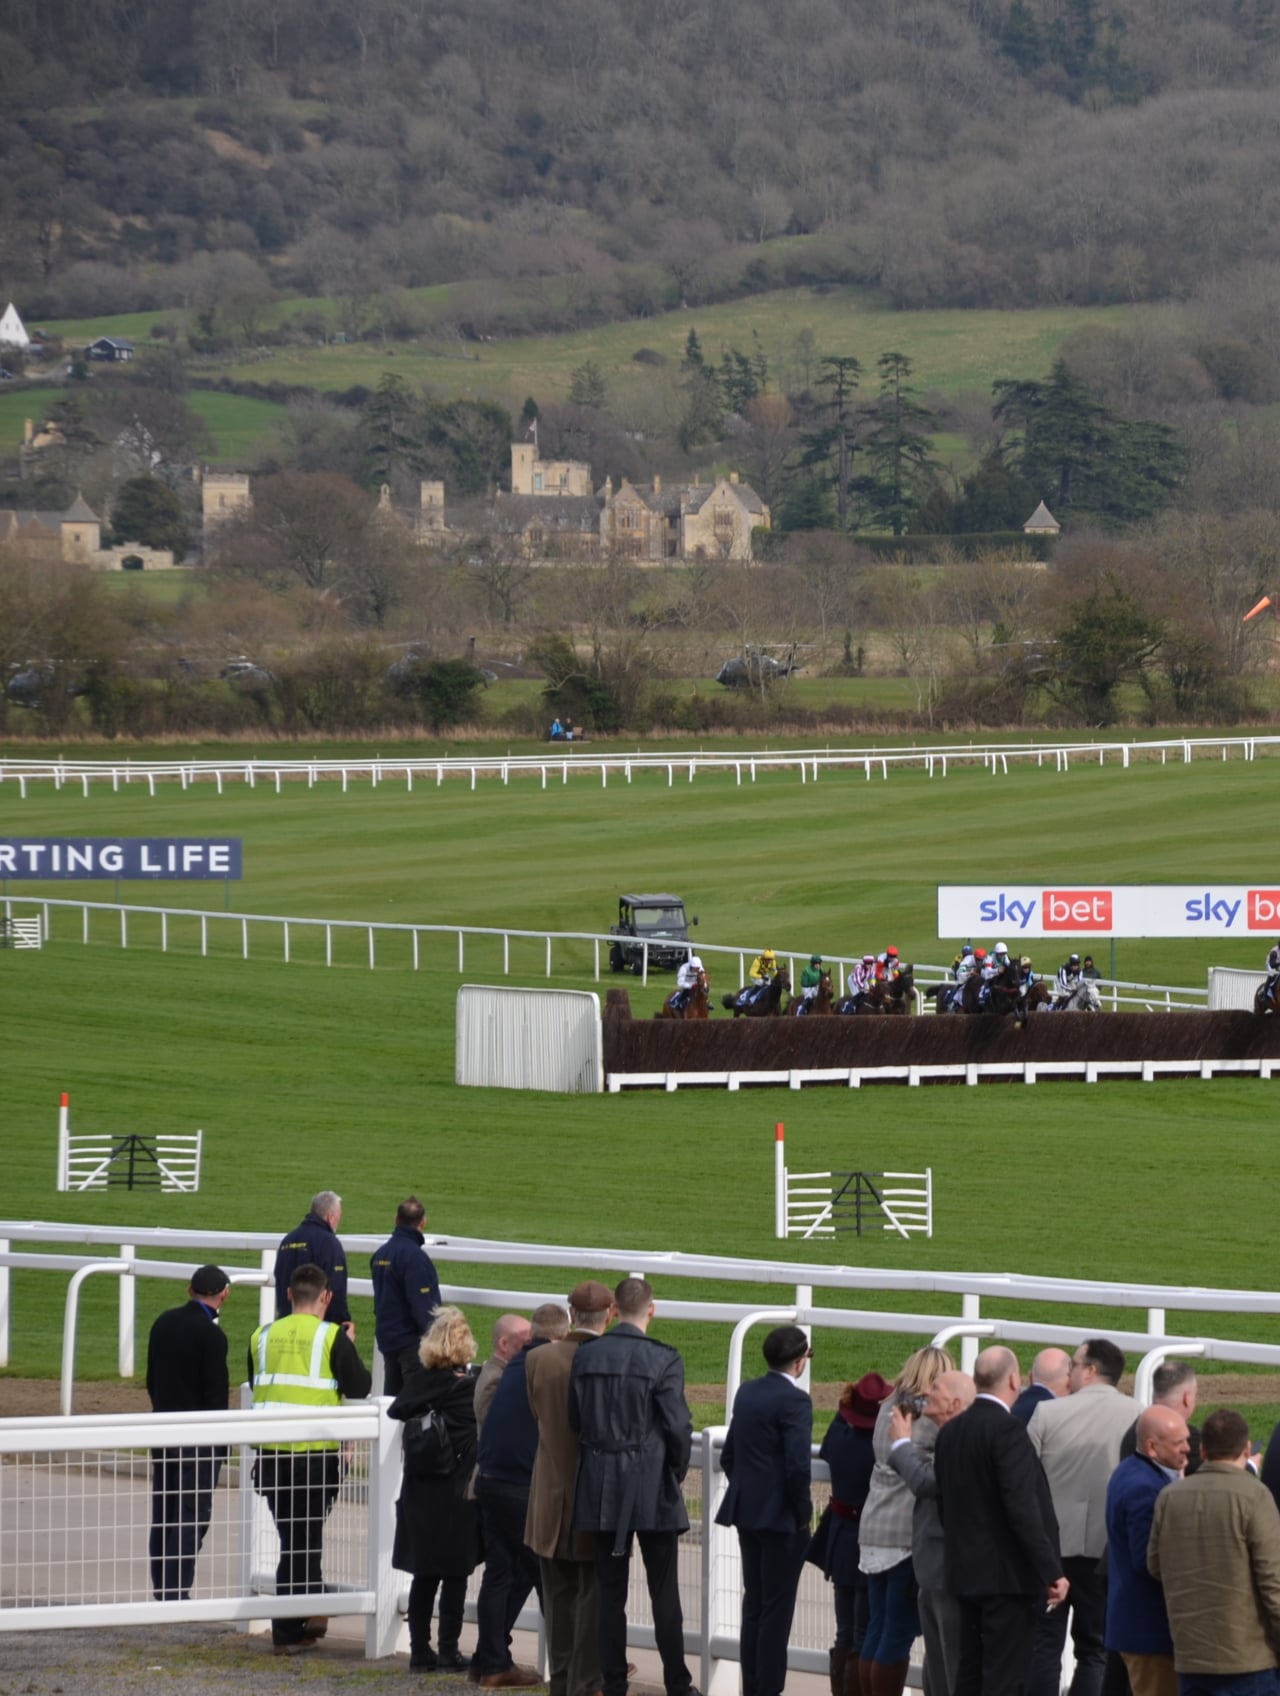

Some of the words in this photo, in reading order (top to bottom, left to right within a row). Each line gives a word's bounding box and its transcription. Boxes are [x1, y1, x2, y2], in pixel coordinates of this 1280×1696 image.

[0, 845, 123, 871] RTING
[141, 845, 229, 871] LIFE
[980, 893, 1036, 929] sky
[1050, 894, 1106, 922] bet
[1185, 892, 1242, 928] sky
